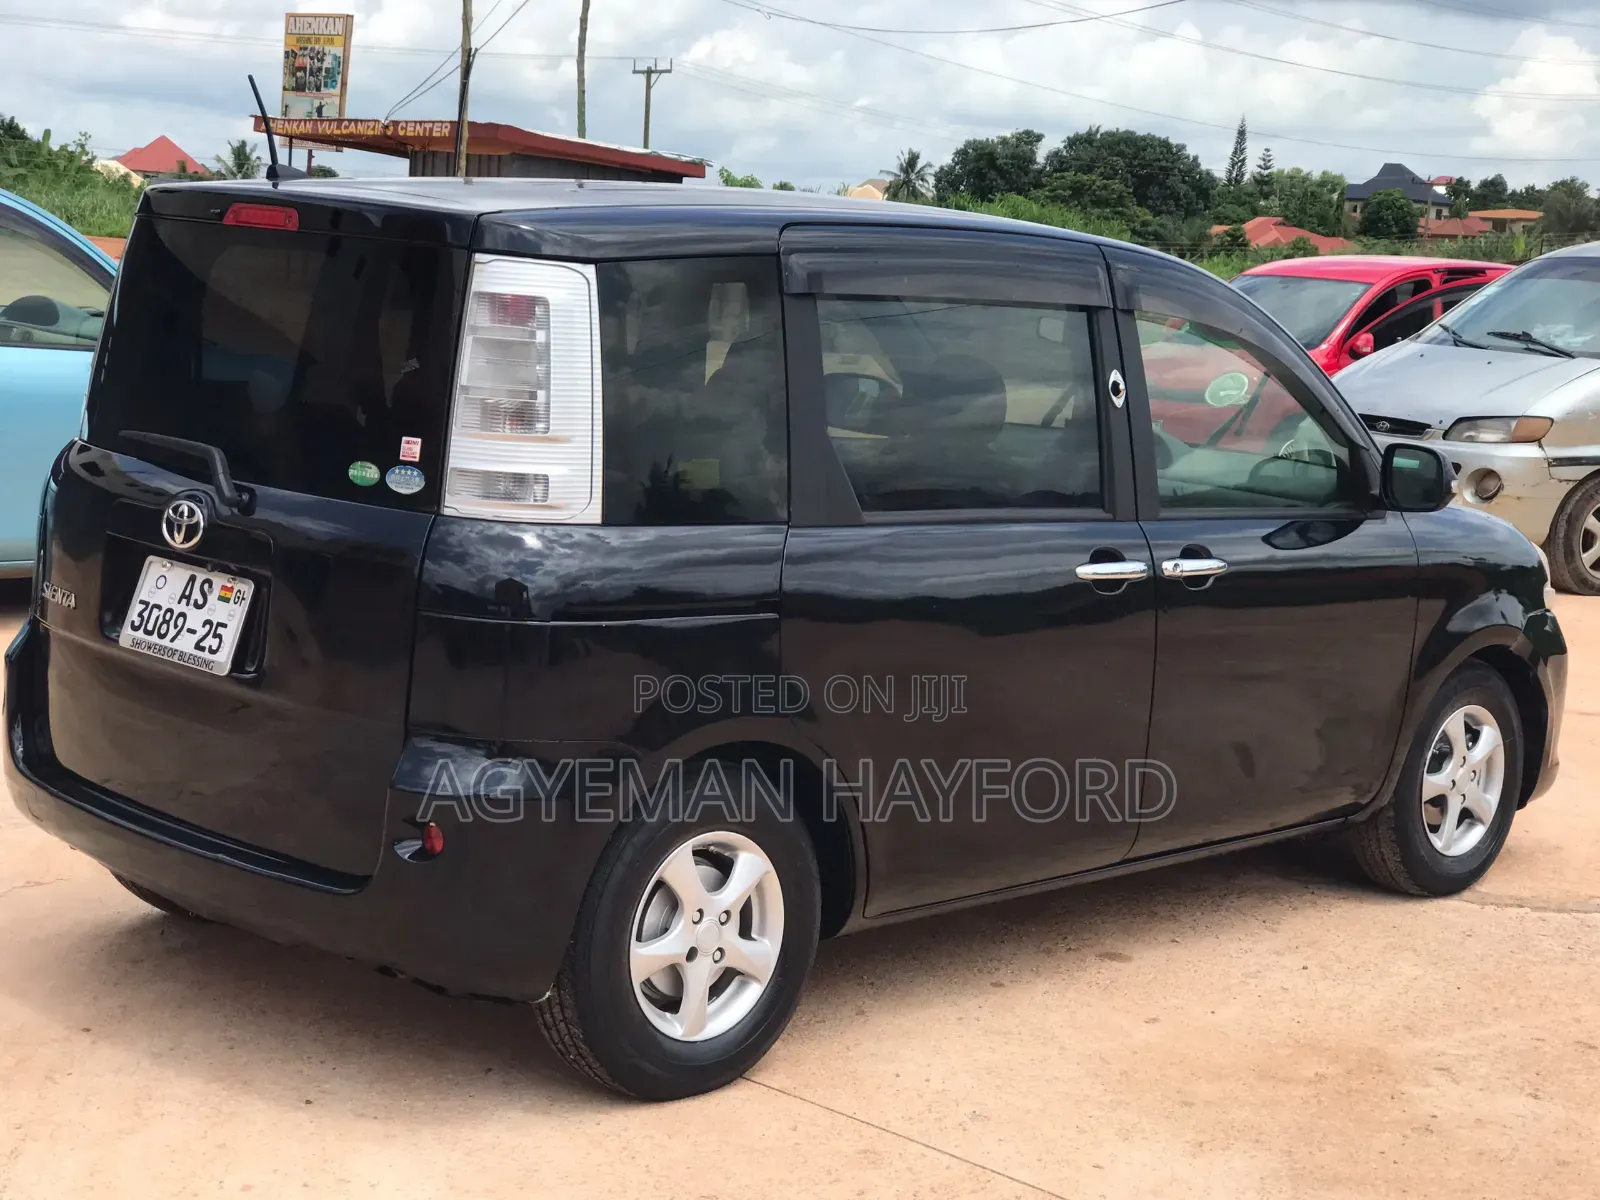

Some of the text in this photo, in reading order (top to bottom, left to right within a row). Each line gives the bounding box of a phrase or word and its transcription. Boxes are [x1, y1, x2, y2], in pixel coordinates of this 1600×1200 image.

[287, 16, 343, 35] AHENKAN
[397, 121, 451, 137] CENTER
[42, 581, 76, 609] SIENTA
[177, 573, 214, 610] AS
[130, 599, 228, 655] 3089-25
[130, 637, 215, 671] SHOWERS OF BLESSING
